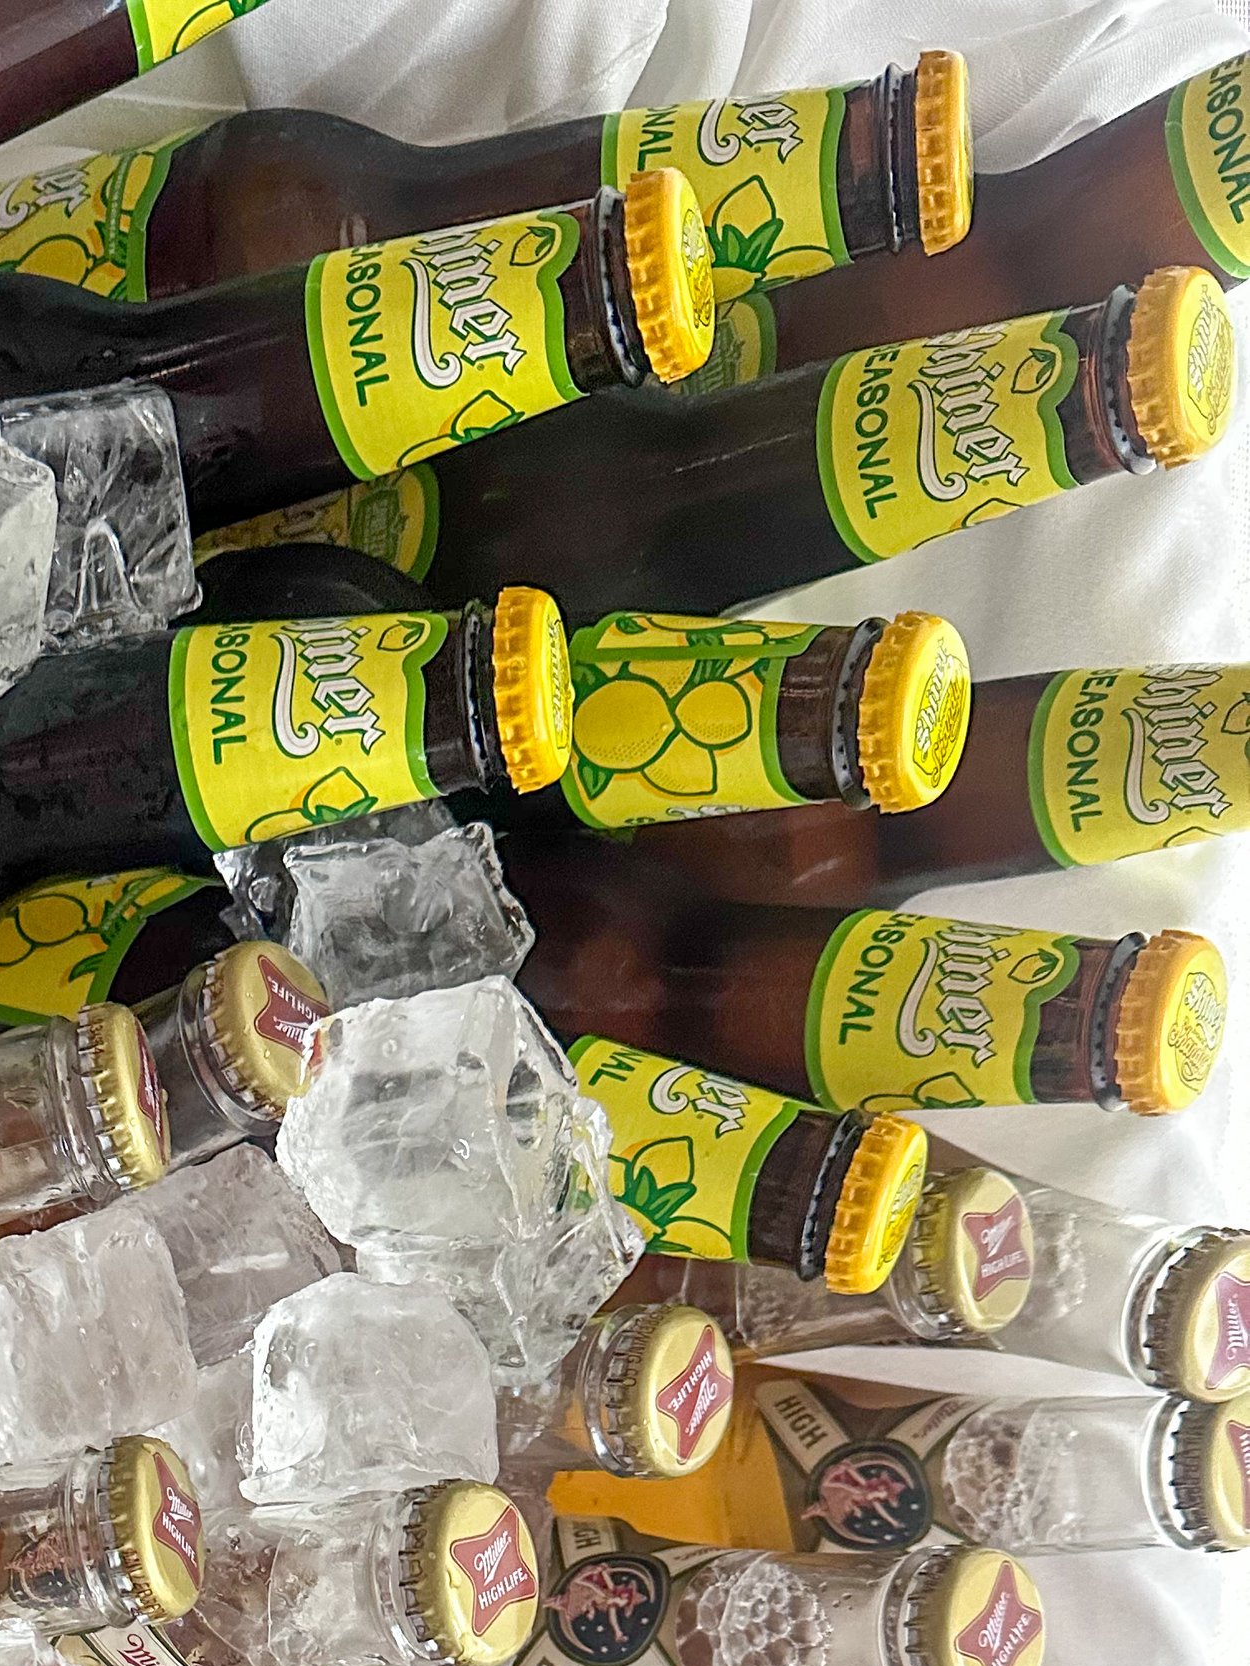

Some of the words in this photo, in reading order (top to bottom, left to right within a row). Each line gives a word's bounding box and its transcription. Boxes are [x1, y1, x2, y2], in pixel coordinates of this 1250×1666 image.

[1206, 53, 1250, 225] EASONAL
[271, 979, 296, 1009] LIFE
[275, 1018, 308, 1045] iller
[1226, 1292, 1249, 1361] Miller
[691, 1350, 713, 1387] HIGH
[670, 1380, 693, 1413] LIFE
[687, 1373, 719, 1437] Miller
[773, 1396, 831, 1449] HIGH
[166, 1486, 195, 1526] Miller
[162, 1512, 182, 1544] HIGH
[180, 1539, 197, 1567] LIFE
[472, 1528, 513, 1586] Miller
[478, 1582, 509, 1610] HIGH
[502, 1566, 528, 1594] LIFE
[978, 1592, 1009, 1657] Miller
[1010, 1612, 1031, 1645] LIFE
